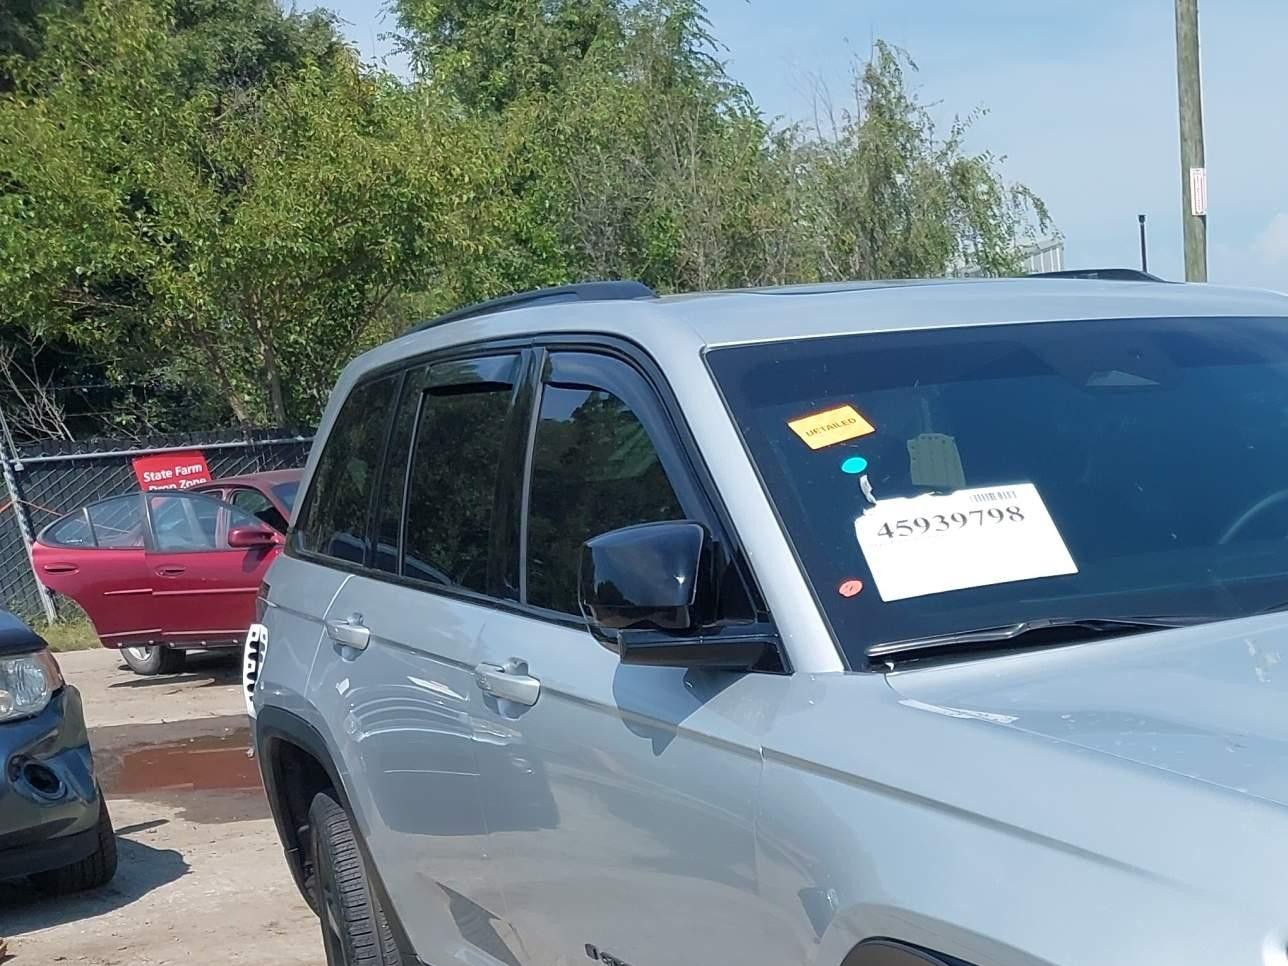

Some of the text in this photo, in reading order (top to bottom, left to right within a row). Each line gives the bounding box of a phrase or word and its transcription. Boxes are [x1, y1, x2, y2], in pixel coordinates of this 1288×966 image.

[805, 417, 857, 437] DETAILED
[143, 464, 202, 482] State Farm
[877, 504, 1026, 539] 45939798
